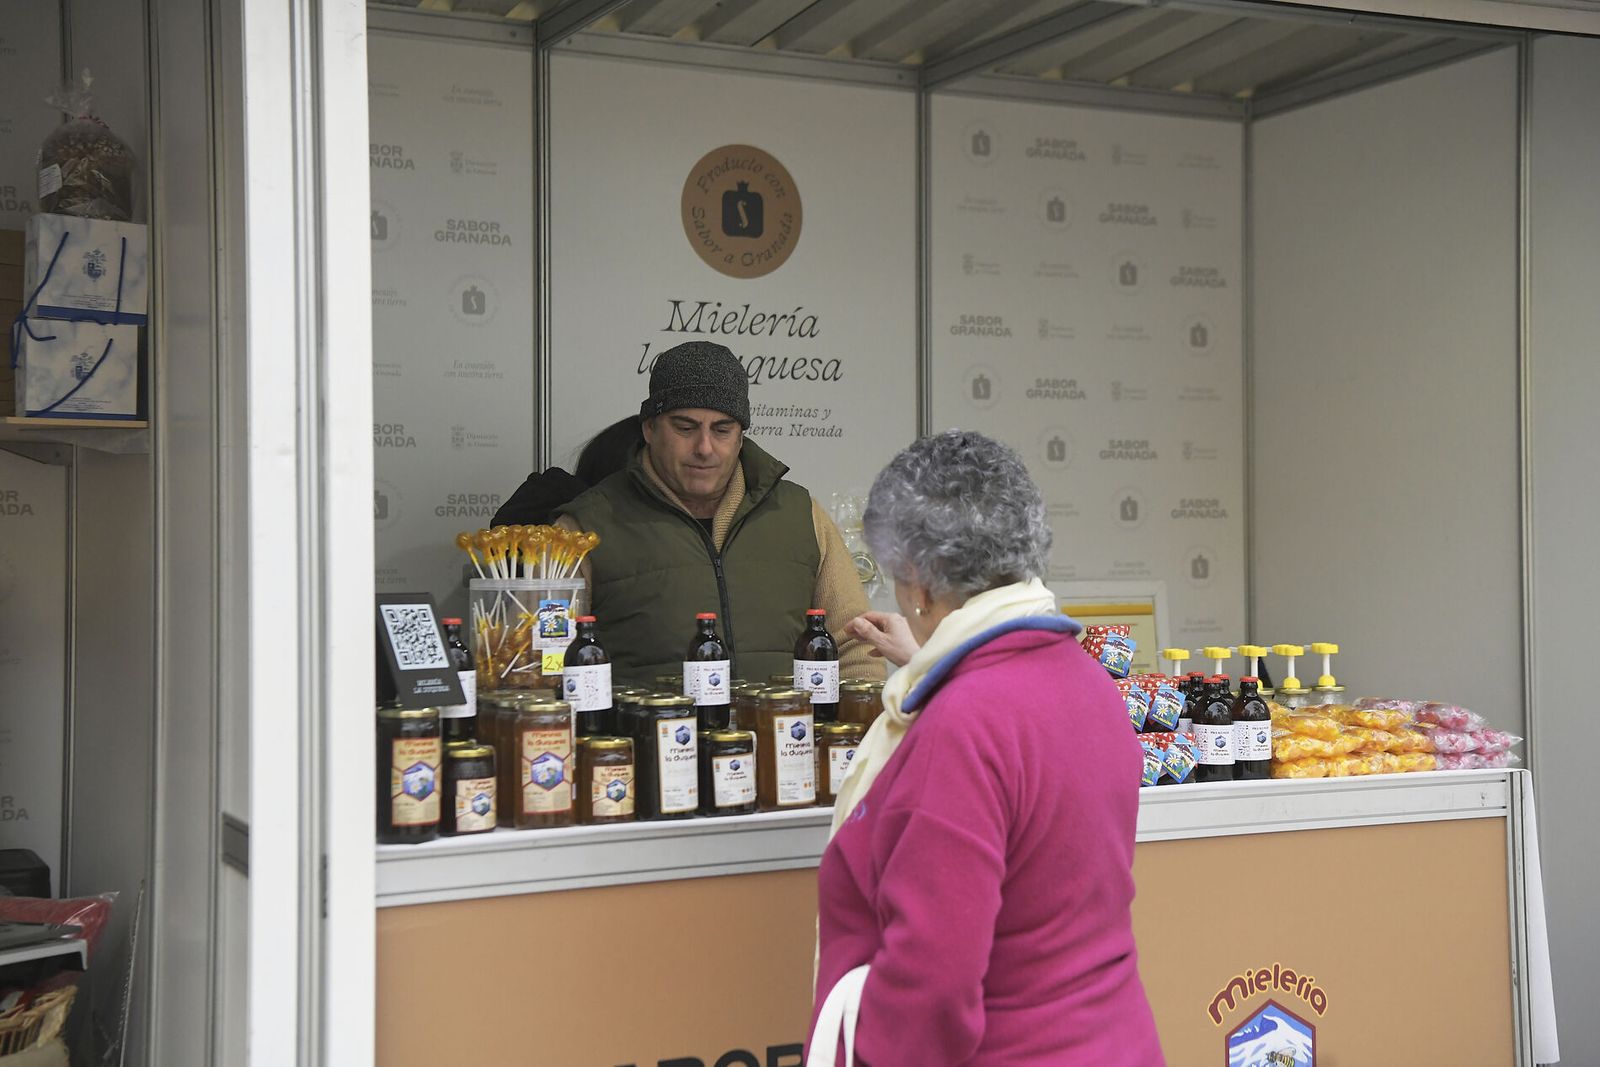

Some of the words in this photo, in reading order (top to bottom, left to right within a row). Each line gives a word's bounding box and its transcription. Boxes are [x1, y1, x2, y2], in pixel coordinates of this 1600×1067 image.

[1035, 137, 1077, 149] SABOR
[370, 143, 403, 157] BOR
[1026, 147, 1086, 161] GRANADA
[370, 156, 416, 170] NADA
[696, 156, 764, 194] Producto
[764, 173, 786, 198] con
[1108, 203, 1150, 214] SABOR
[446, 219, 501, 233] SABOR
[1099, 213, 1158, 226] GRANADA
[434, 231, 512, 246] GRANADA
[692, 206, 722, 253] Sabor
[724, 254, 735, 264] a
[741, 211, 793, 267] Granada
[1179, 266, 1219, 277] SABOR
[1170, 275, 1228, 288] GRANADA
[659, 299, 821, 338] Mielería
[960, 314, 1003, 326] SABOR
[950, 325, 1012, 338] GRANADA
[738, 355, 844, 385] quesa
[1035, 379, 1078, 389] SABOR
[1026, 389, 1086, 401] GRANADA
[748, 403, 818, 418] vitaminas
[821, 407, 832, 421] y
[373, 424, 405, 436] BOR
[788, 424, 844, 438] Nevada
[373, 435, 417, 448] NADA
[1108, 439, 1150, 450] SABOR
[1099, 449, 1158, 460] GRANADA
[446, 493, 501, 505] SABOR
[1179, 498, 1220, 509] SABOR
[1170, 508, 1228, 520] GRANADA
